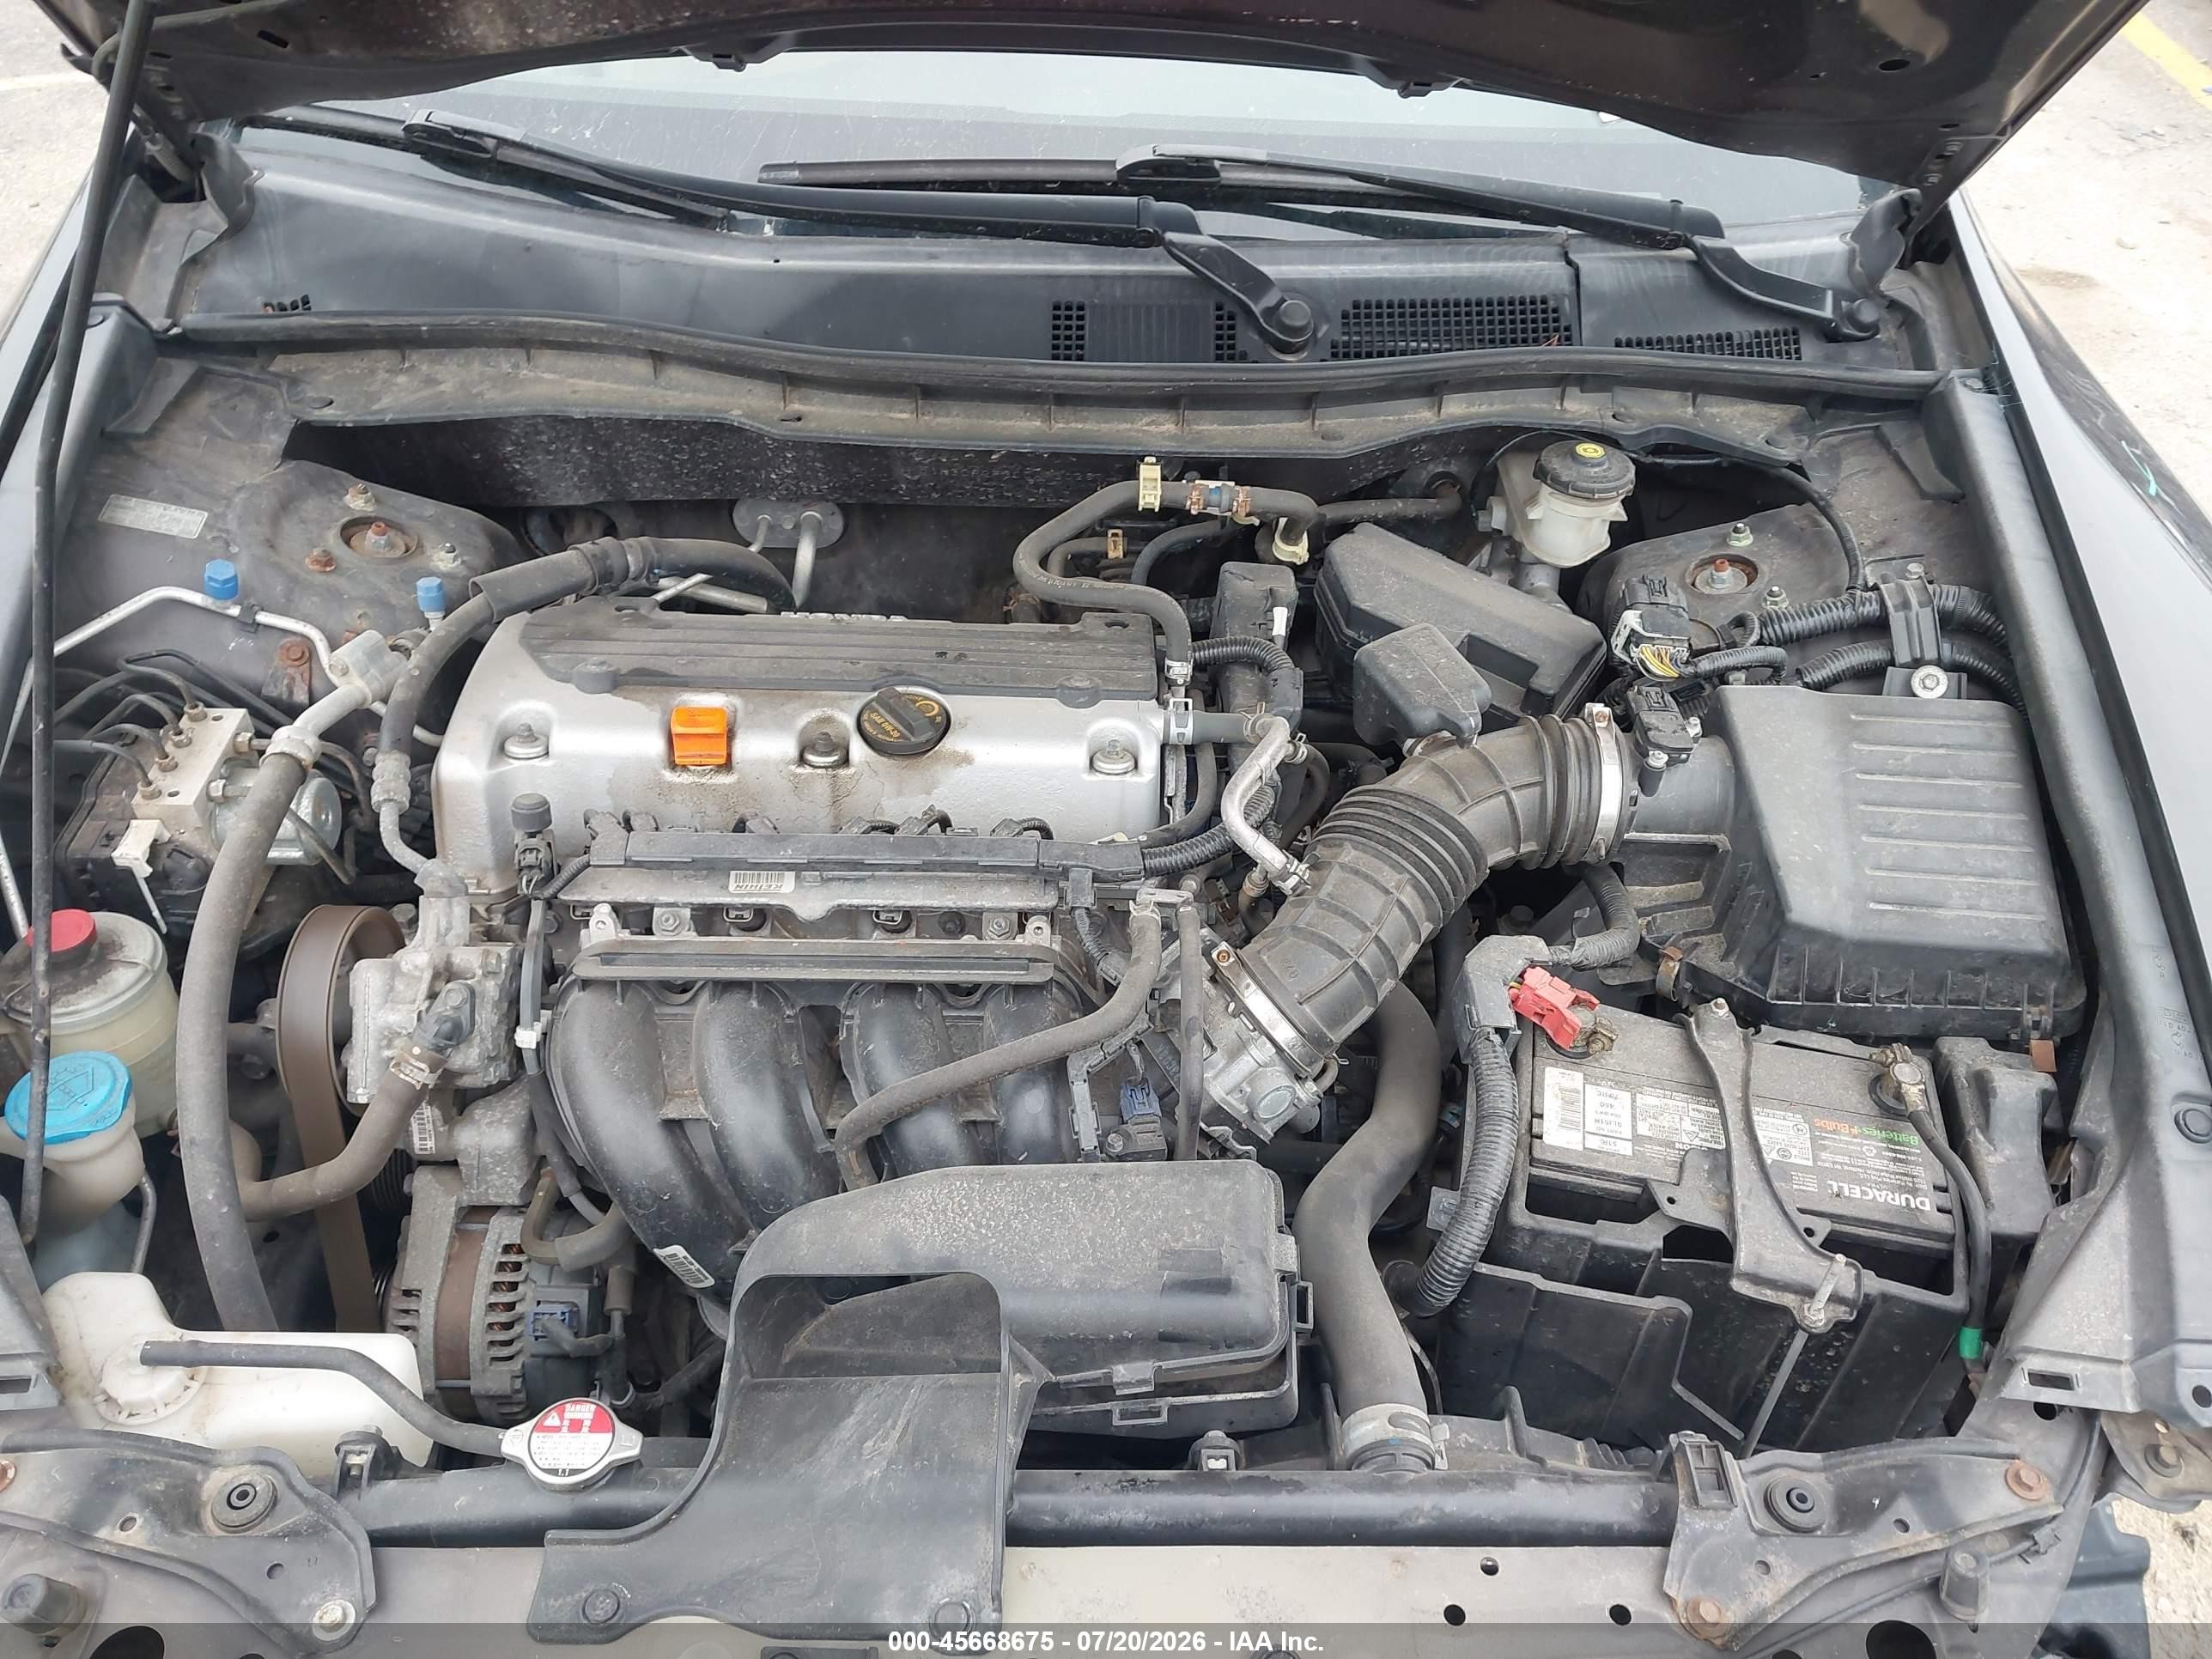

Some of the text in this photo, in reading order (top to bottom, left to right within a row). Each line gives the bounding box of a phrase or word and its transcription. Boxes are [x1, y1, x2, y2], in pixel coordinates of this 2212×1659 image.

[870, 712, 885, 727] SAE
[1814, 1118, 1849, 1133] Bulbs
[1863, 1127, 1918, 1146] Batteries
[1827, 1180, 1930, 1211] DURACELL
[564, 1403, 597, 1413] DANGER
